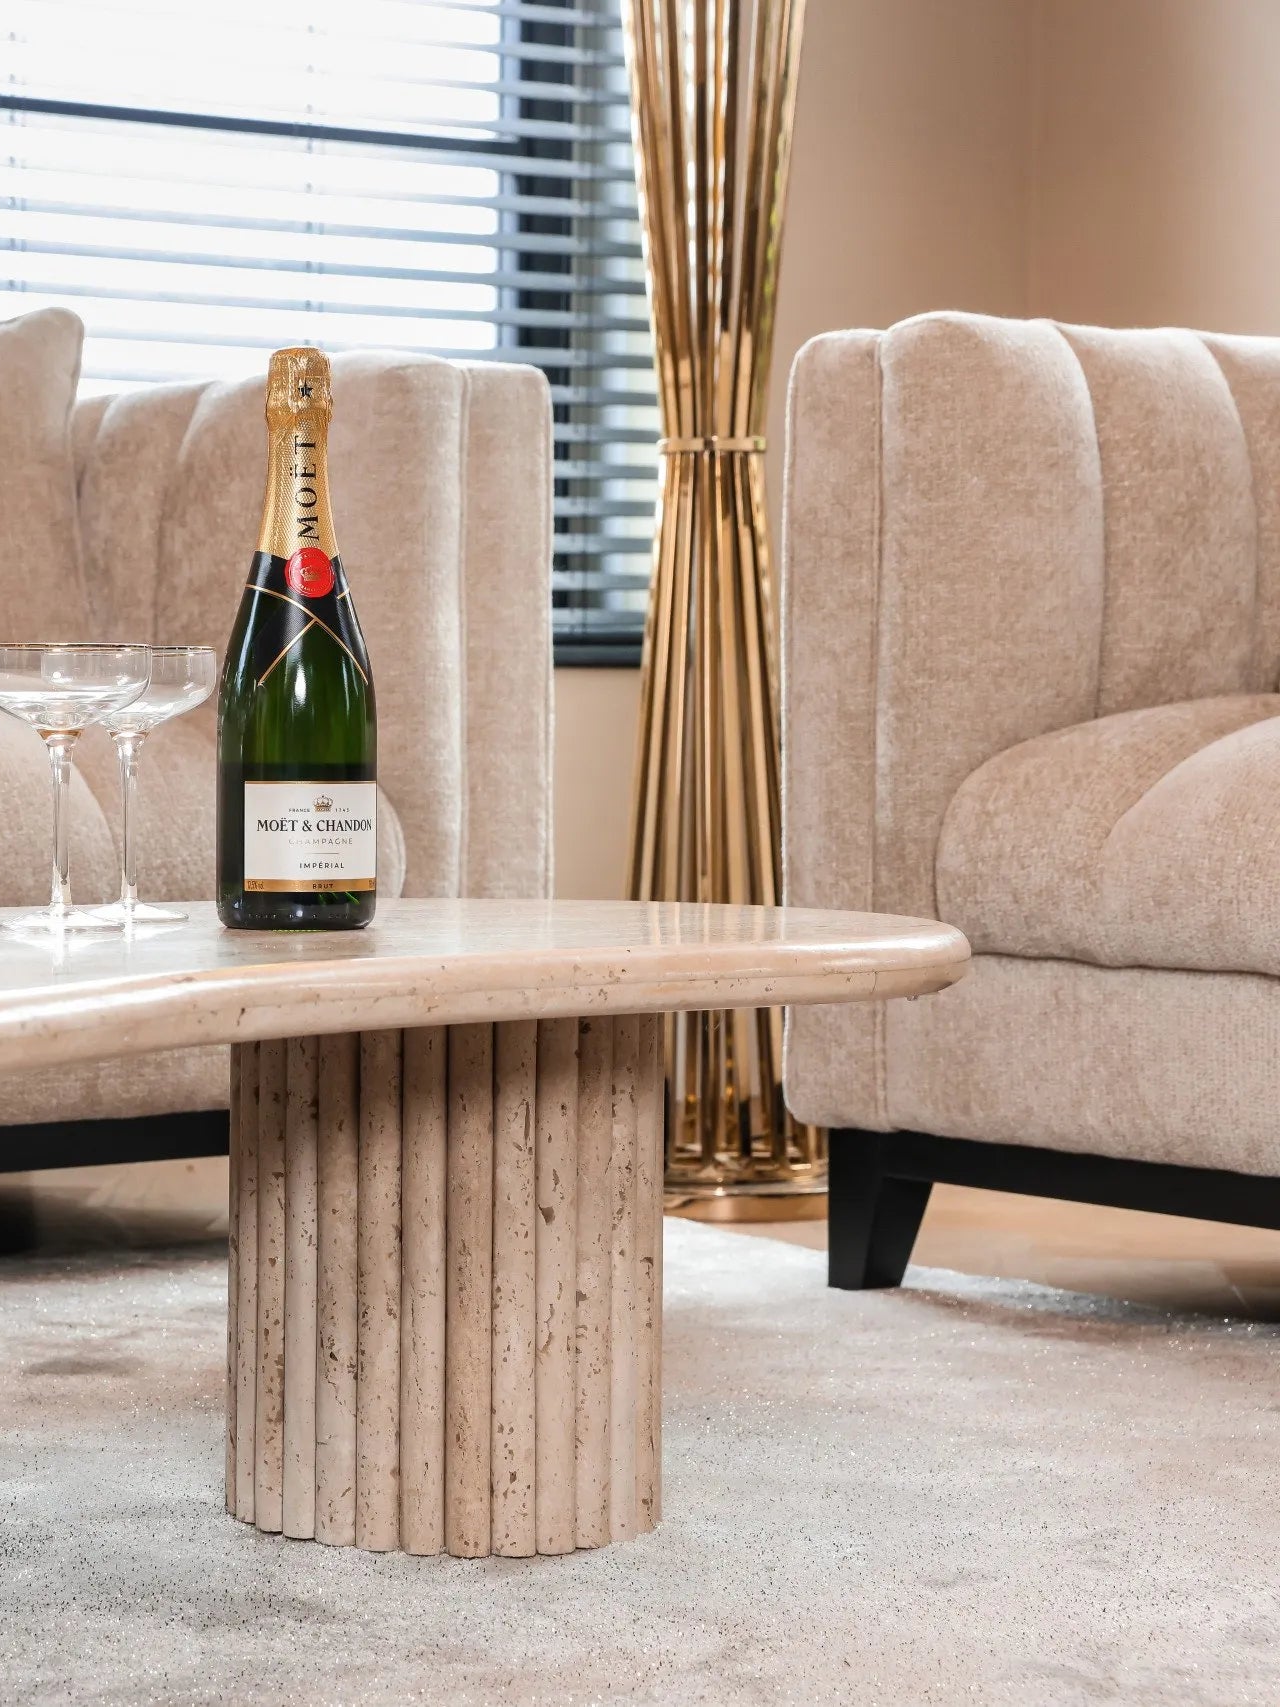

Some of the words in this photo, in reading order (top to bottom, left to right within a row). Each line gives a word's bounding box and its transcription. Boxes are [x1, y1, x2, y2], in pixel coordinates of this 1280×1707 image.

[289, 435, 320, 541] MOËT
[257, 818, 298, 832] MOËT
[302, 819, 313, 832] &
[317, 819, 372, 832] CHANDON
[299, 861, 345, 869] IMPÉRIAL
